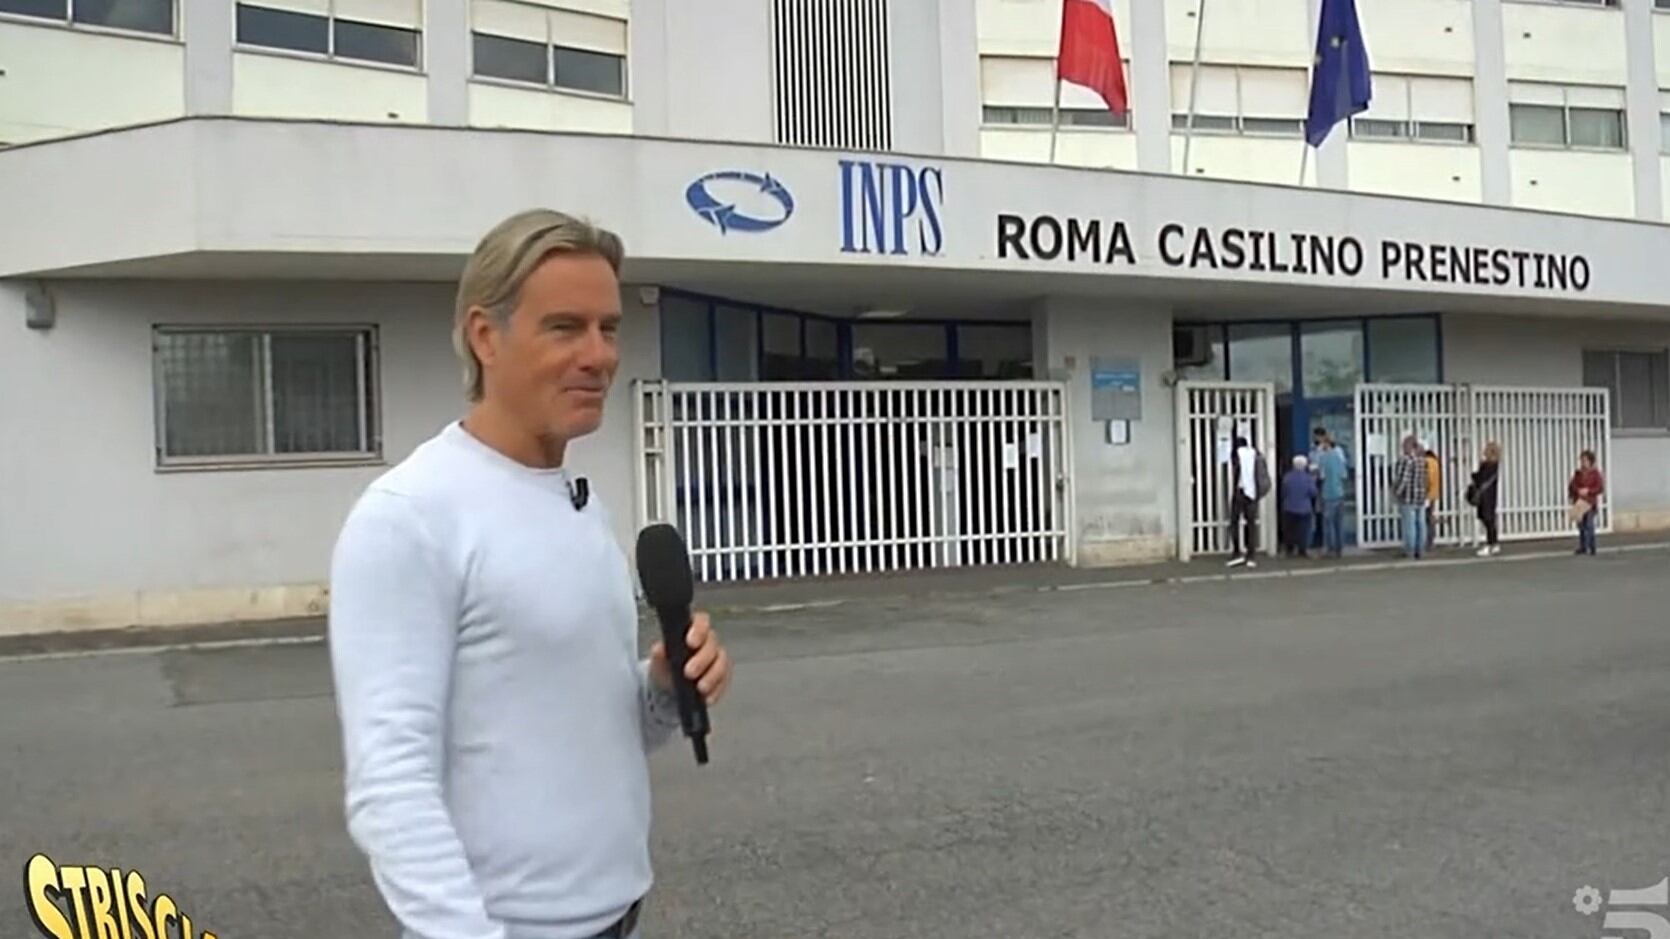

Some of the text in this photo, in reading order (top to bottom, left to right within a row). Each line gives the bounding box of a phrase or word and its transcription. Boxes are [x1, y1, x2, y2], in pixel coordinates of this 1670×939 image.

[838, 160, 943, 256] INPS
[997, 214, 1591, 291] ROMA CASILINO PRENESTINO
